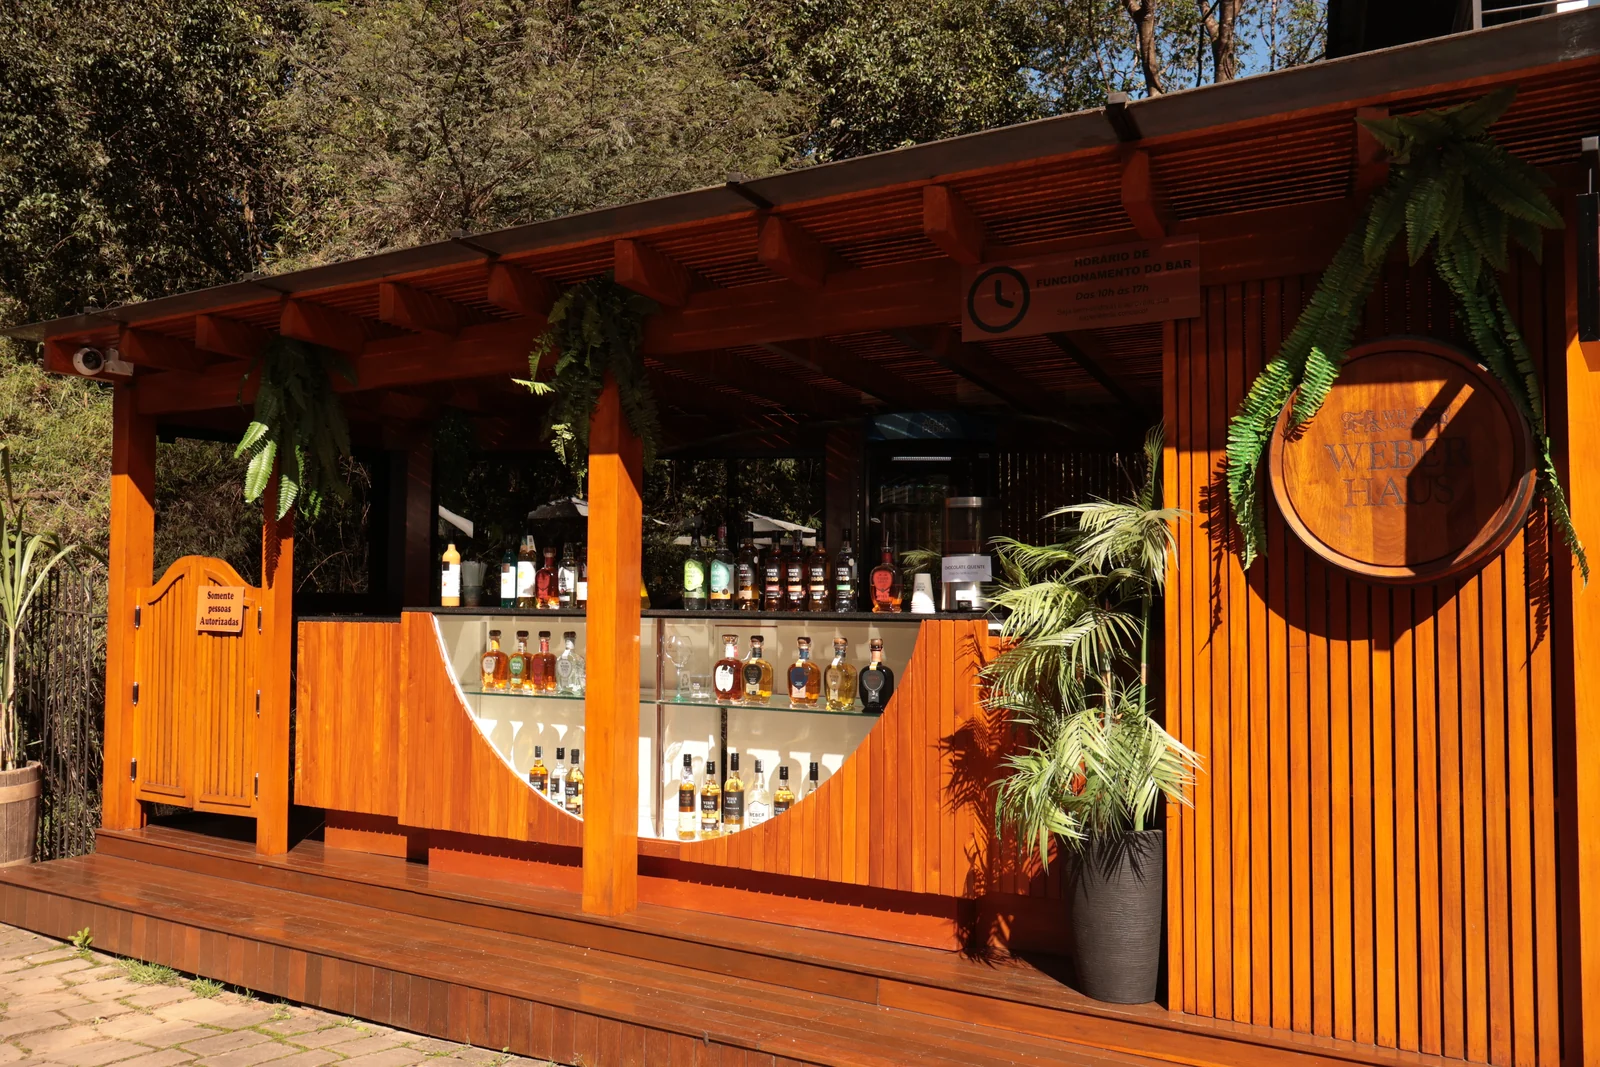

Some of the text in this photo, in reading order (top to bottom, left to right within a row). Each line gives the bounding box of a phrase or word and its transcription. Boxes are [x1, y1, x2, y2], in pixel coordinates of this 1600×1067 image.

[1074, 249, 1150, 268] HORÁRIO DE
[1036, 259, 1192, 288] FUNCIONAMENTO DO BAR
[1075, 290, 1095, 302] Das
[1098, 287, 1115, 298] 10h
[1132, 284, 1149, 294] 17h
[1324, 437, 1469, 472] WEBER
[1342, 475, 1454, 508] HAUS
[207, 590, 234, 600] Somente
[208, 605, 232, 614] pessoas
[200, 616, 239, 626] Autorizadas
